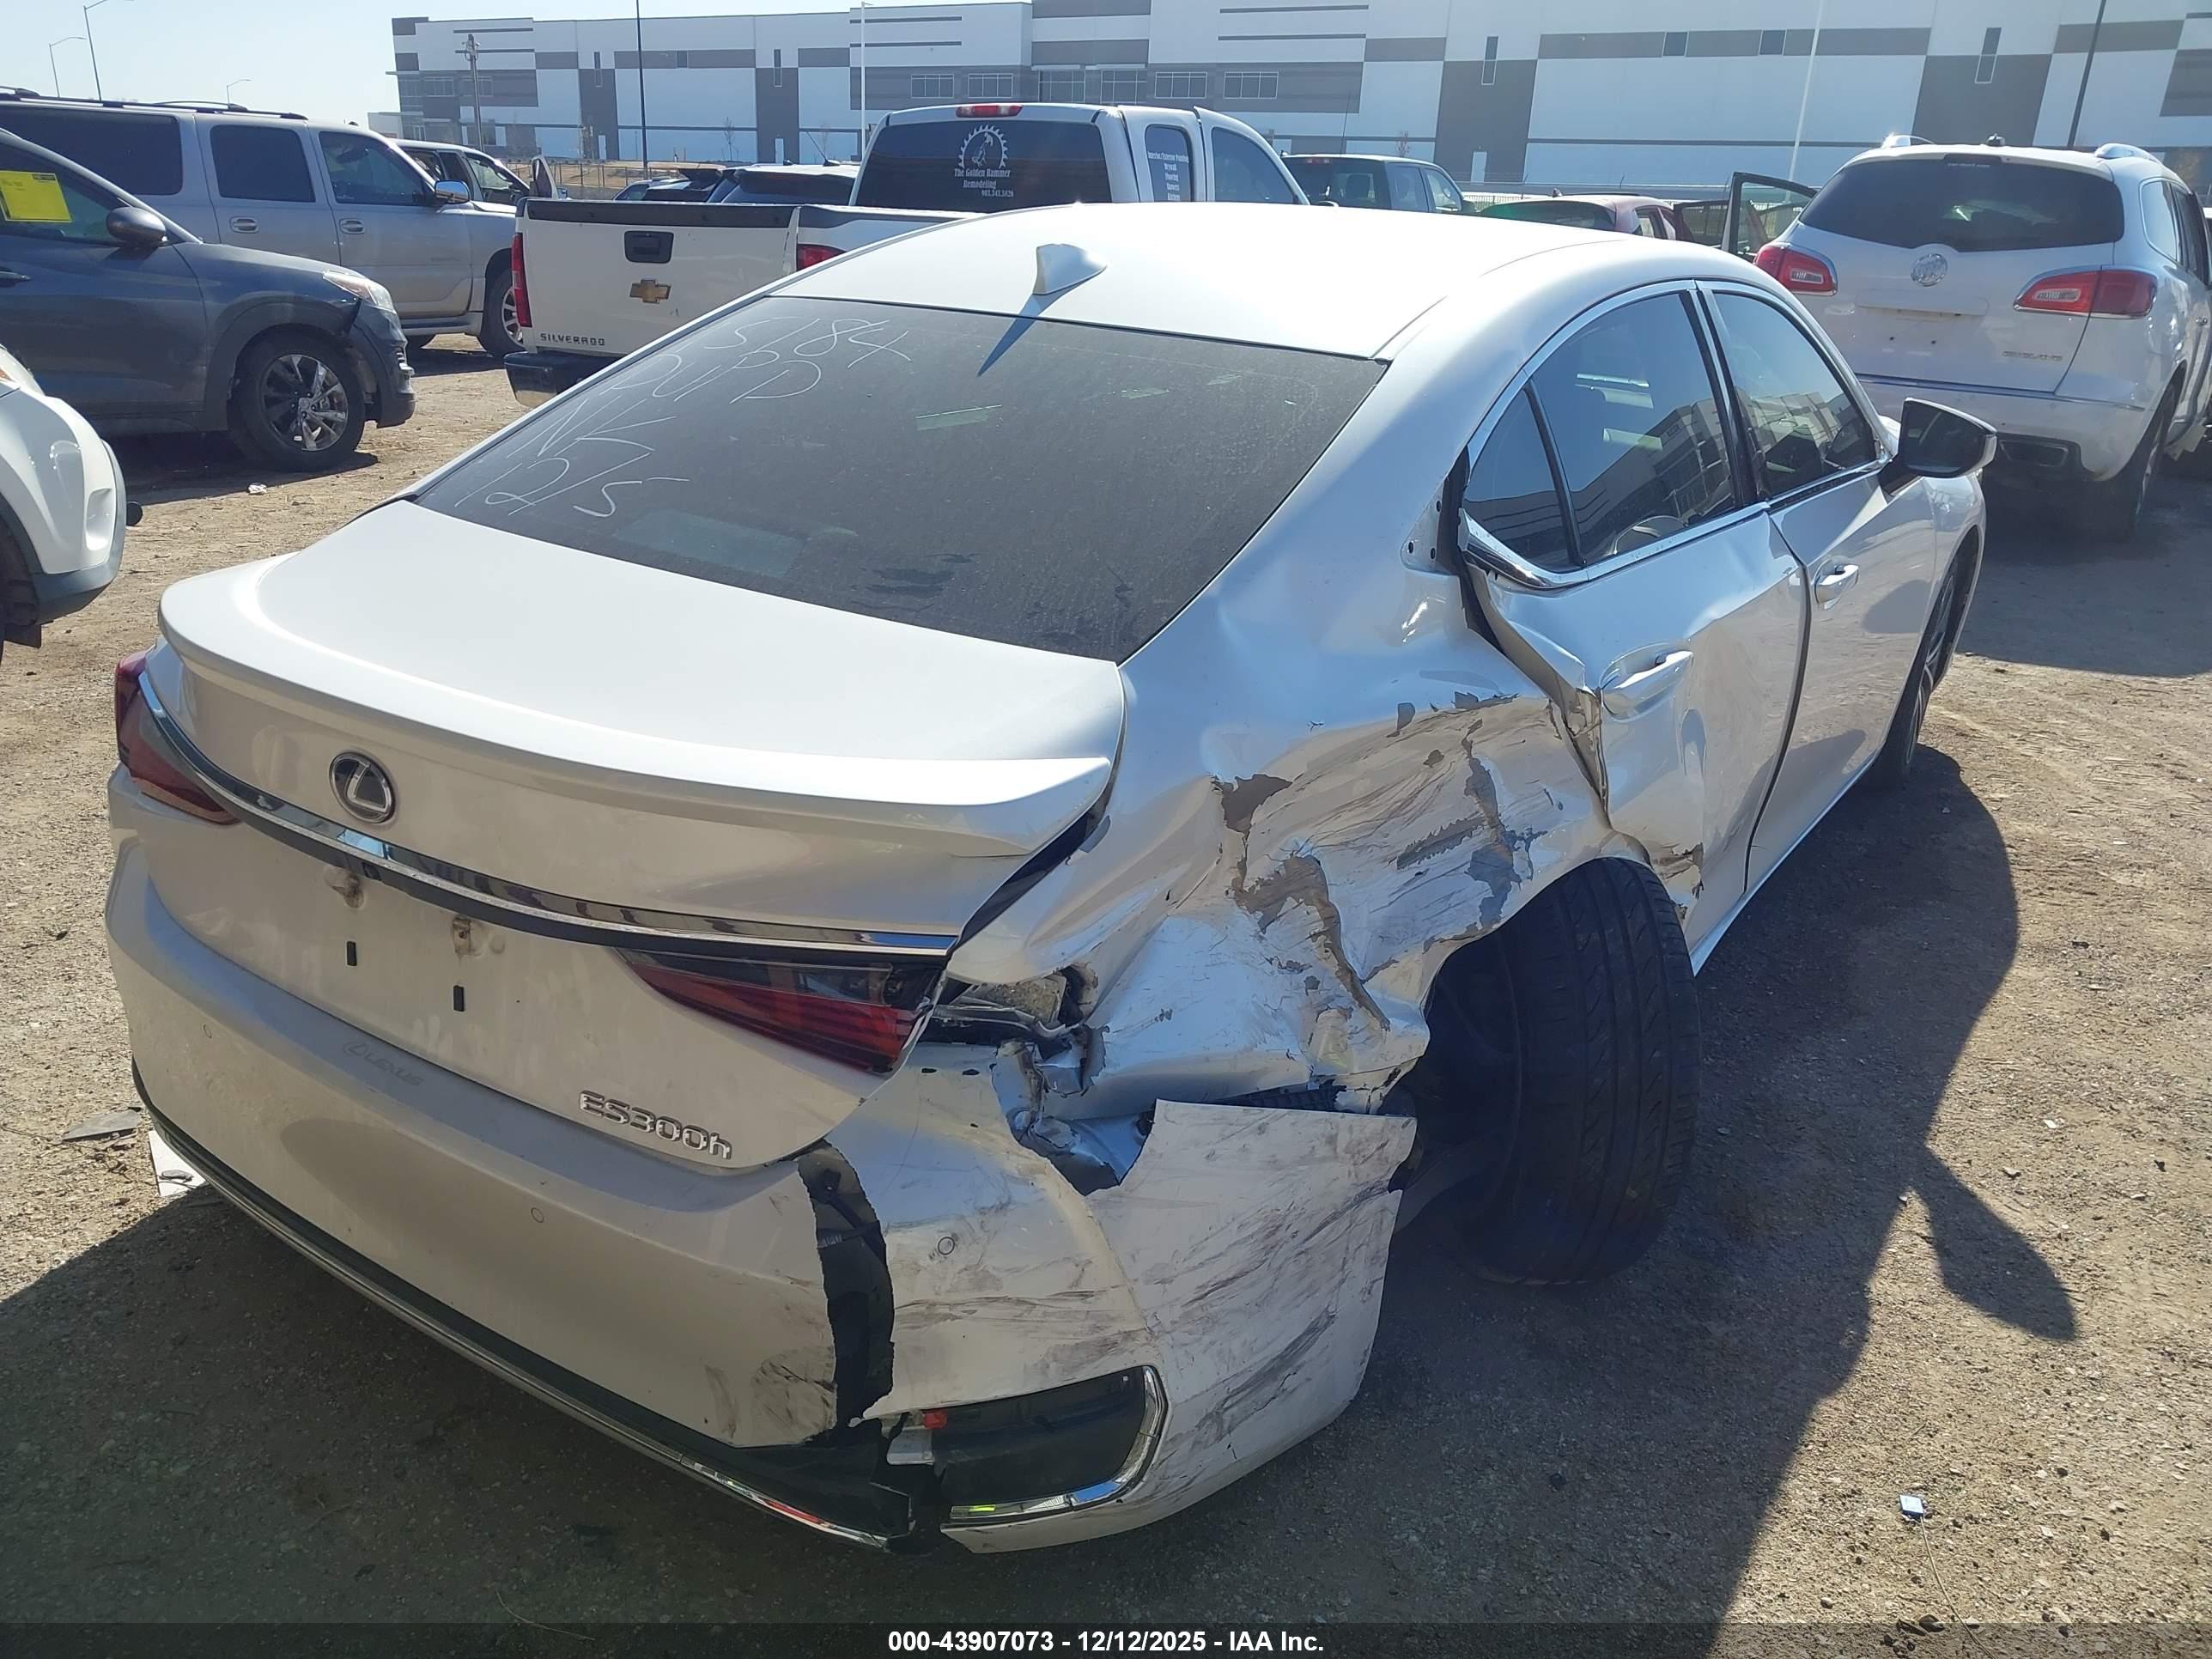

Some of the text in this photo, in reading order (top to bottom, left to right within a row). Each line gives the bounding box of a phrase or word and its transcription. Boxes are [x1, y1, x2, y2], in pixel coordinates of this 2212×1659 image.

[954, 168, 1012, 178] The Golden Hammer
[963, 179, 997, 190] Remodeling
[540, 332, 605, 346] SILVERADO
[579, 1090, 732, 1160] ES300h
